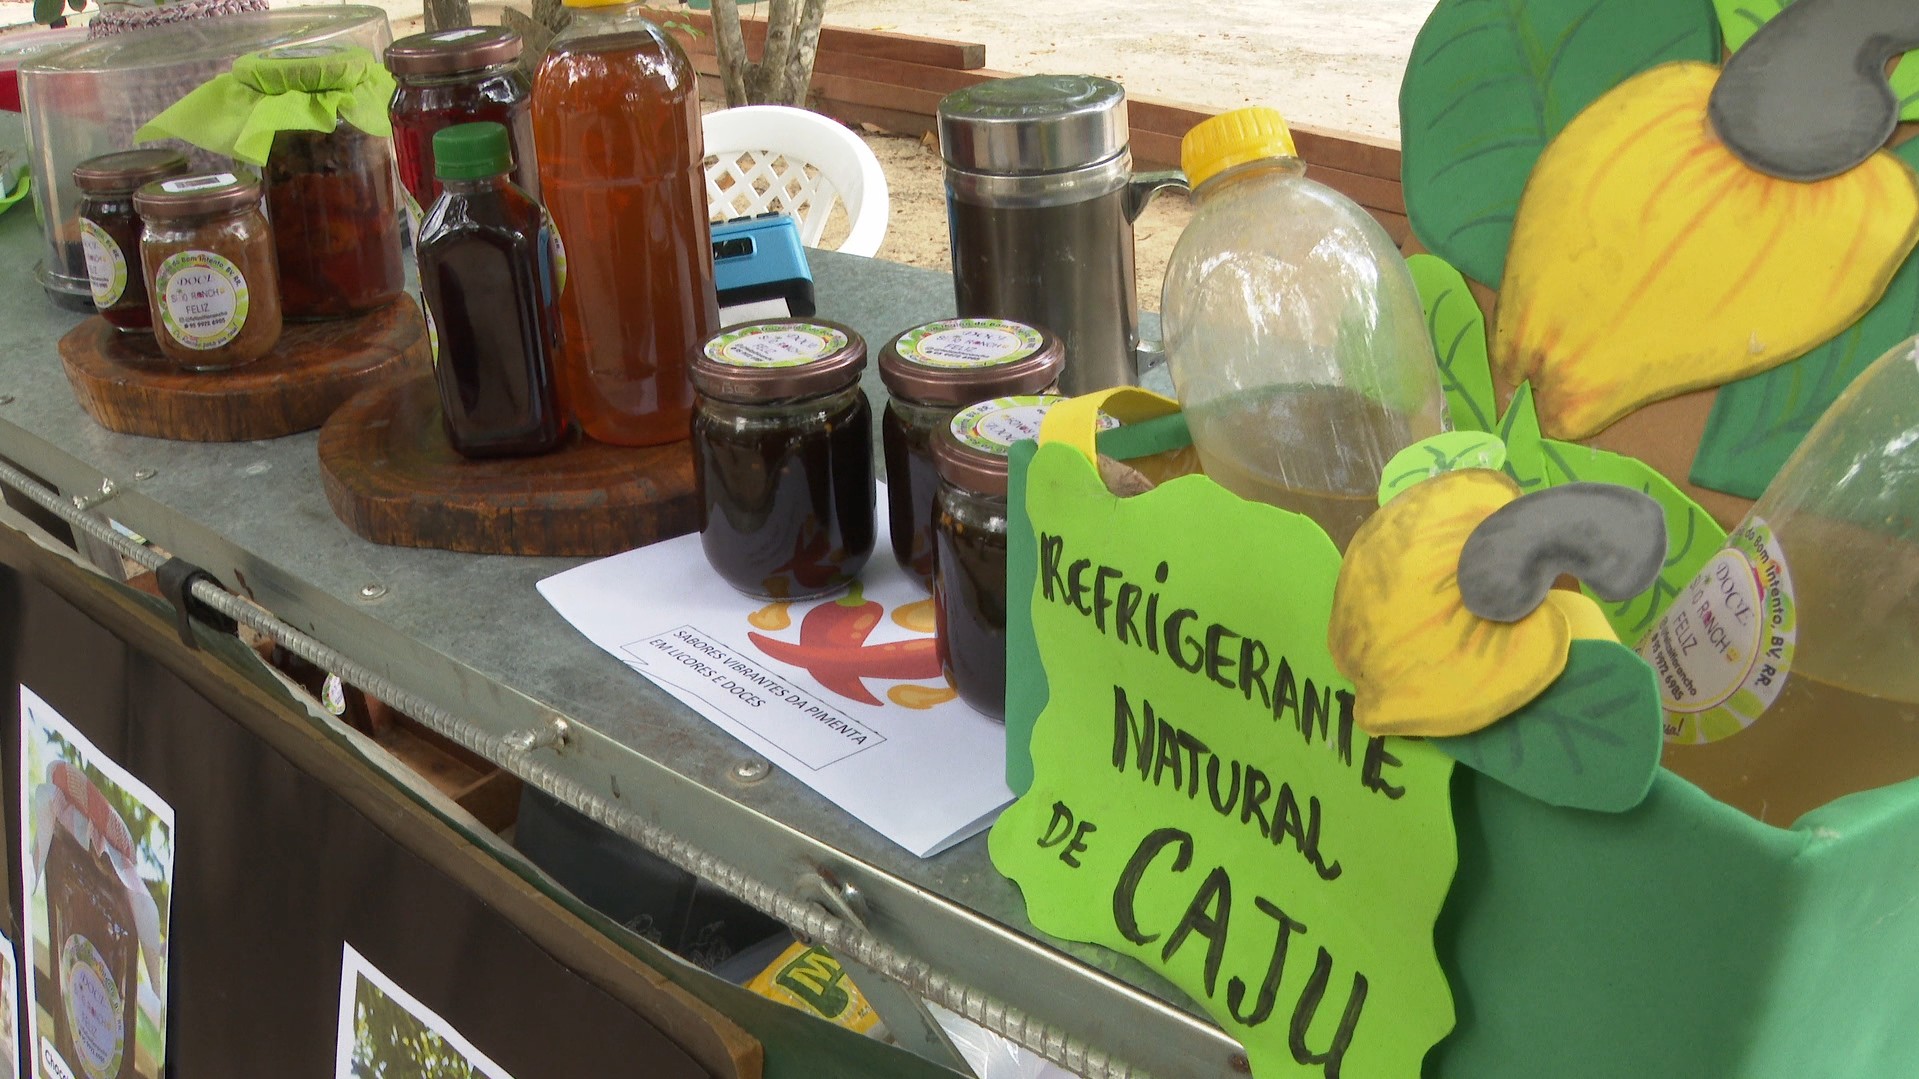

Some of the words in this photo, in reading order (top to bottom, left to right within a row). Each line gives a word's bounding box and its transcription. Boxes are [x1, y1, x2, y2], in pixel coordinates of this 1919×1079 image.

[185, 302, 210, 315] FELIZ
[1753, 535, 1770, 564] Bom
[1765, 564, 1785, 629] Intento,
[1673, 611, 1698, 657] FELIZ
[649, 637, 669, 654] EM
[667, 648, 714, 679] LICORES
[711, 672, 721, 684] E
[720, 679, 767, 709] DOCES
[673, 629, 726, 661] SABORES
[721, 654, 792, 698] VIBRANTES
[784, 692, 807, 710] DA
[804, 705, 869, 746] PIMENTA
[1754, 663, 1776, 688] RR.
[1111, 683, 1343, 881] NATURAL
[1036, 800, 1098, 869] DE
[1111, 826, 1370, 1079] CAJU
